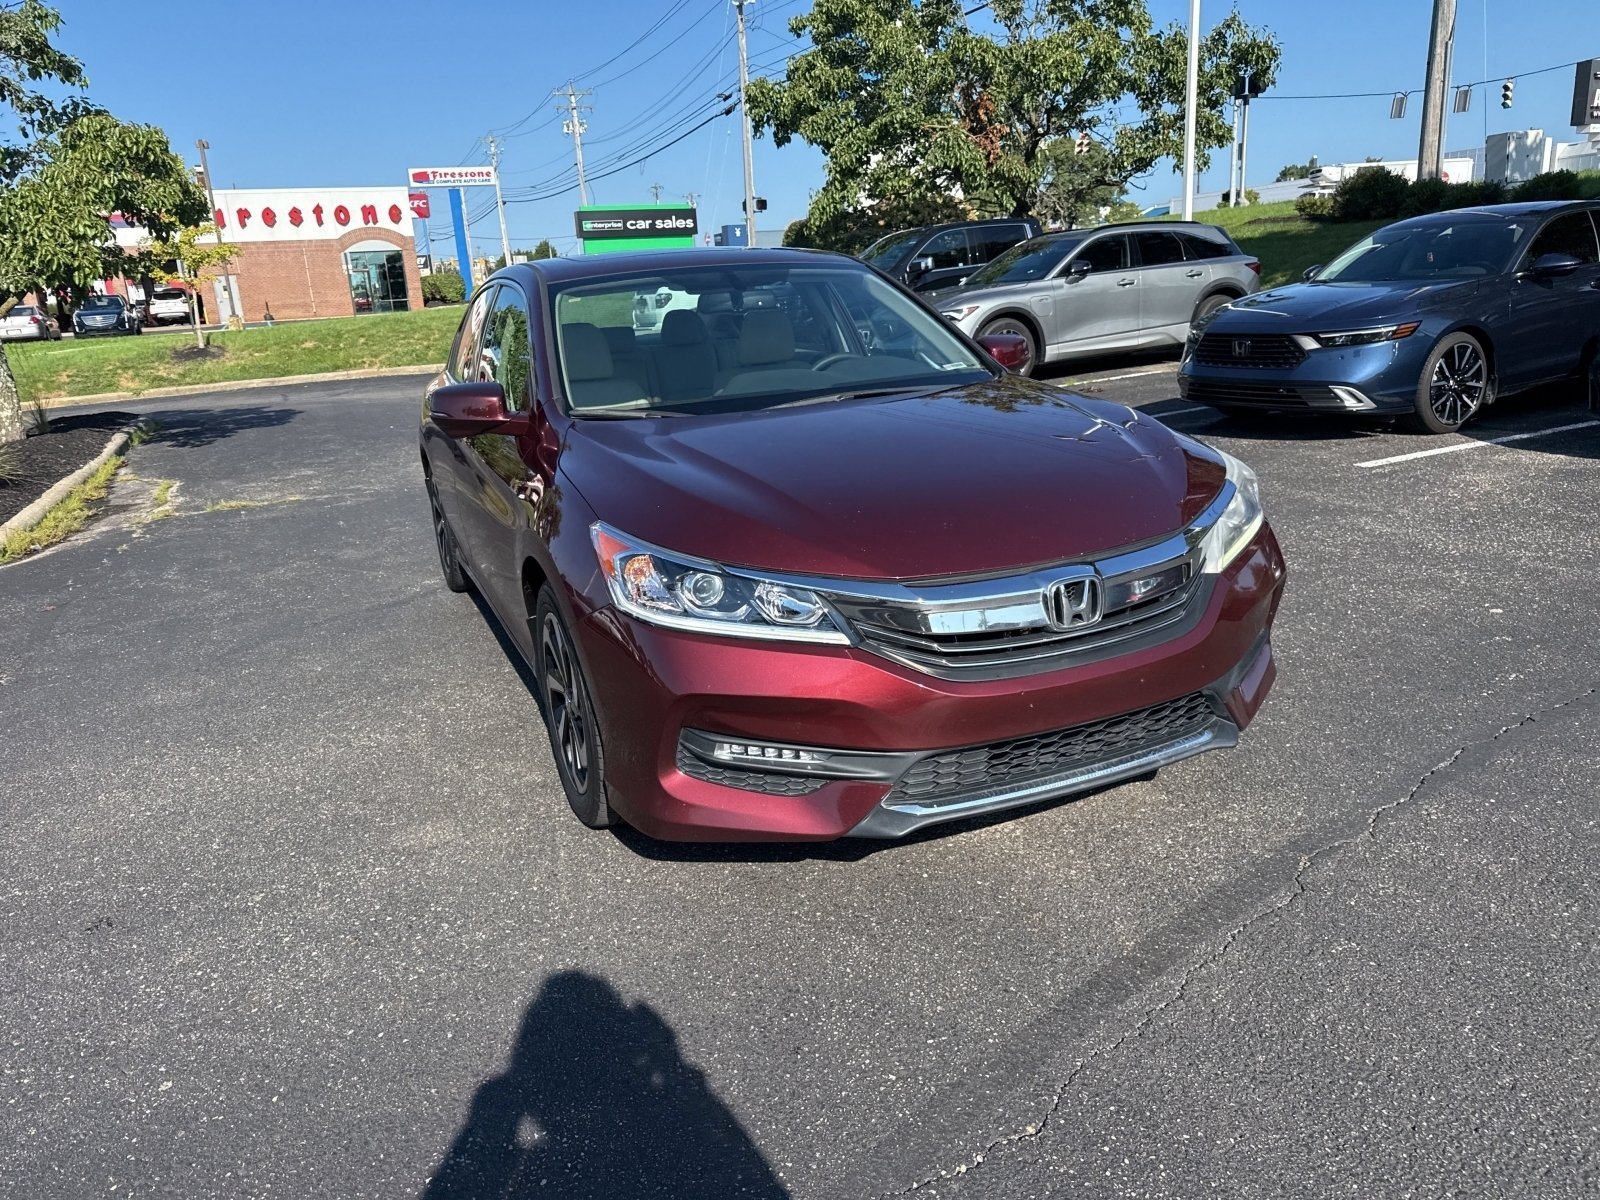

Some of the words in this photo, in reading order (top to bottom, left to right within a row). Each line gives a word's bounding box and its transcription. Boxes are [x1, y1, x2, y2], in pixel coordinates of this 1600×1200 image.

[430, 170, 492, 180] Firestone
[409, 200, 427, 208] KFC
[214, 203, 403, 230] irestone
[584, 221, 622, 230] enterprise
[626, 220, 652, 230] car
[655, 215, 694, 229] sales
